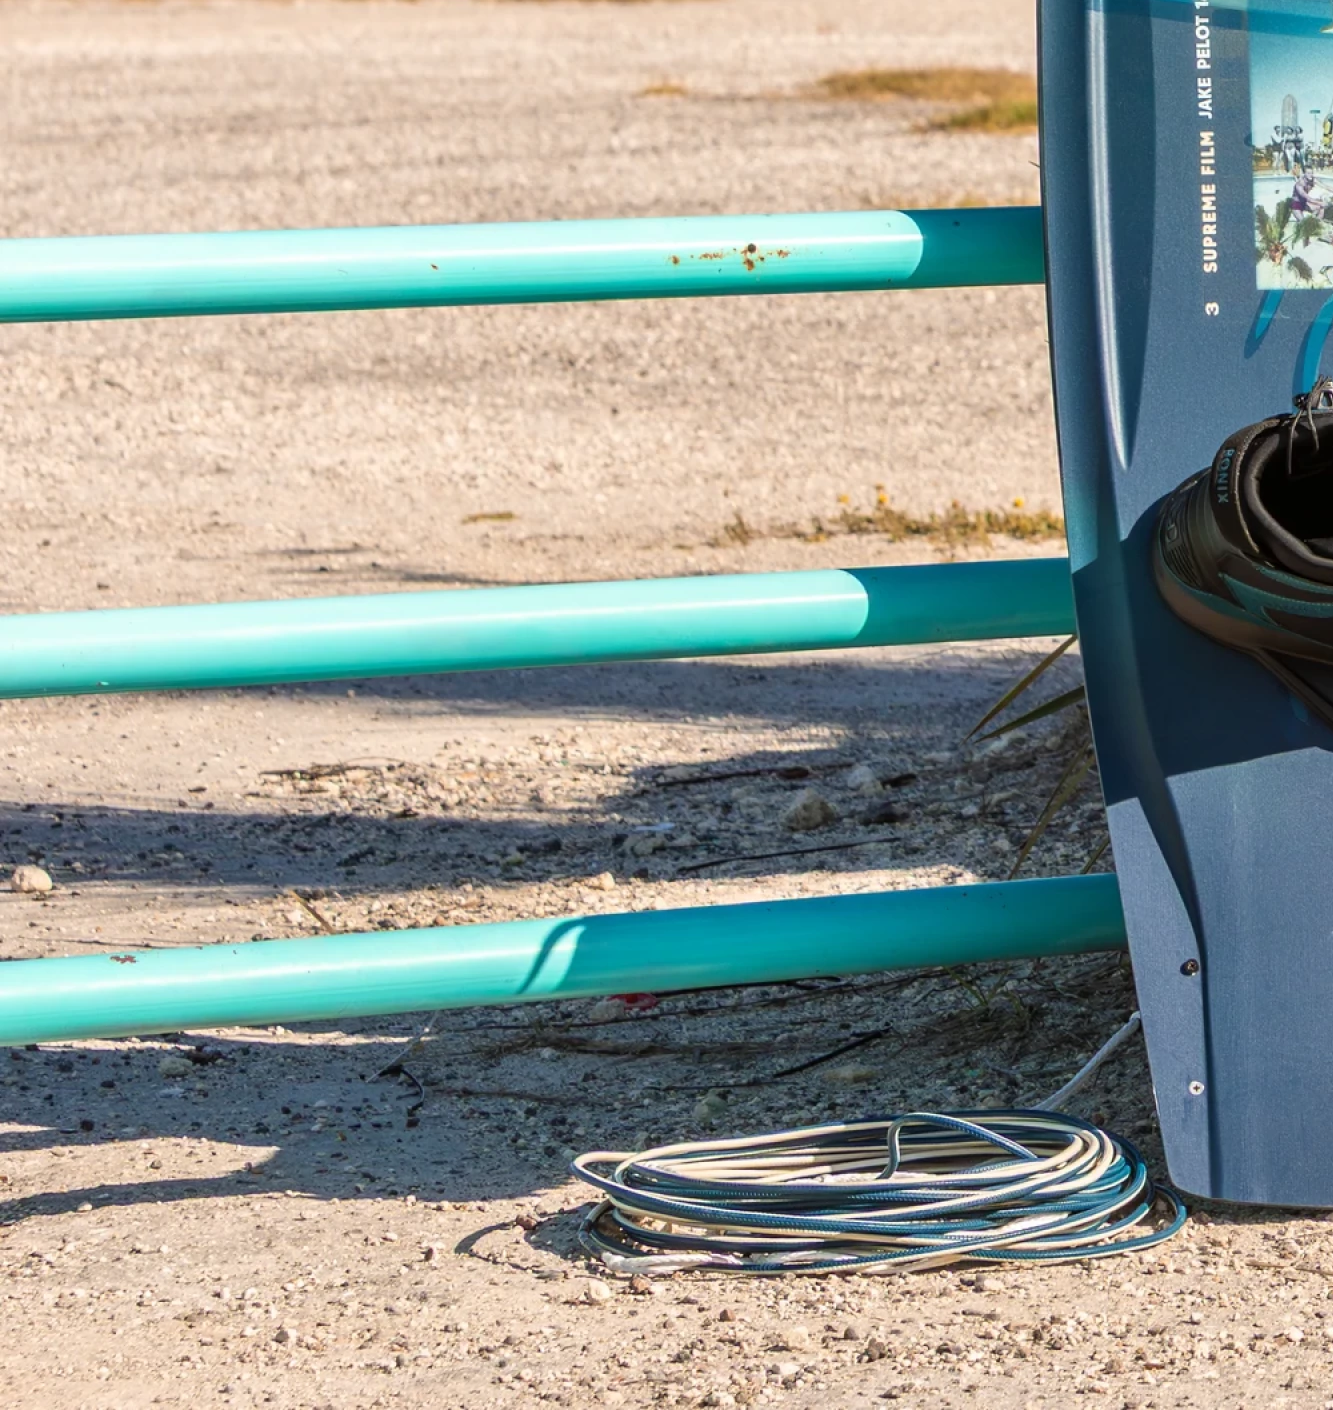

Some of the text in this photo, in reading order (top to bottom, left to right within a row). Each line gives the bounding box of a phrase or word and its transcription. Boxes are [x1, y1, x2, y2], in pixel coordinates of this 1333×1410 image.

[1195, 15, 1212, 70] PELOT
[1197, 77, 1213, 119] JAKE
[1200, 131, 1216, 175] FILM
[1201, 183, 1218, 274] SUPREME
[1205, 301, 1220, 316] 3
[1217, 449, 1235, 504] RONIX
